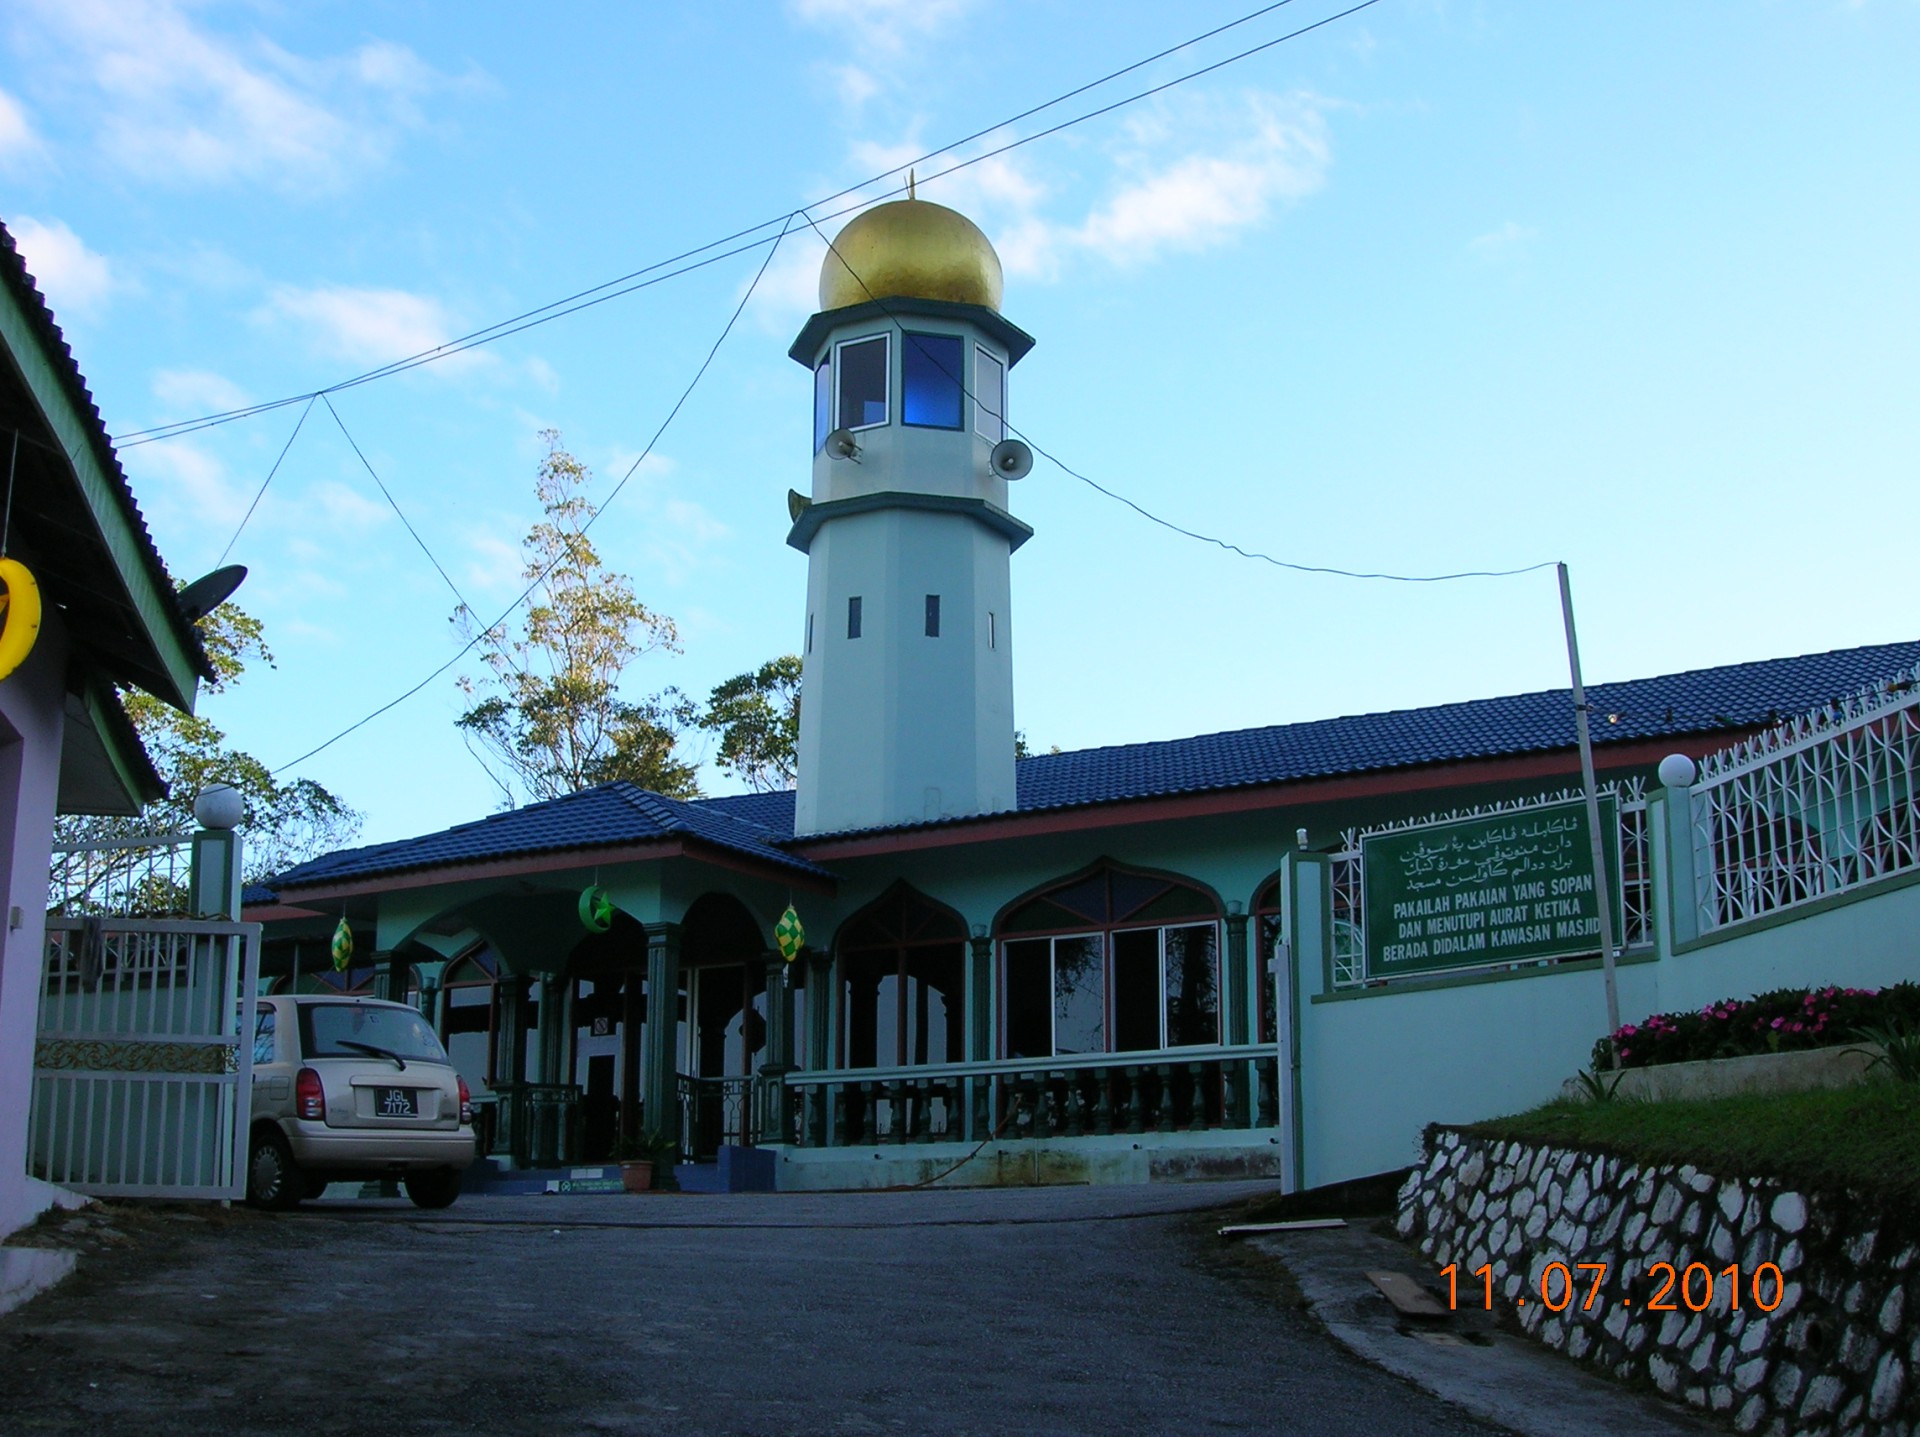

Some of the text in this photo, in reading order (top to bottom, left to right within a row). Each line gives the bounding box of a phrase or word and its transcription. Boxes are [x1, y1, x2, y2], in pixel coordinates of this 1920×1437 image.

[1393, 874, 1592, 919] PAKAILAH PAKAIAN YANG SOPAN
[1398, 897, 1581, 939] DAN MENUTUPI AURAT KETIKA
[1383, 917, 1600, 962] BERADA DIDALAM KAWASAN MASJID
[384, 1101, 411, 1114] 7172
[386, 1089, 408, 1102] JGL
